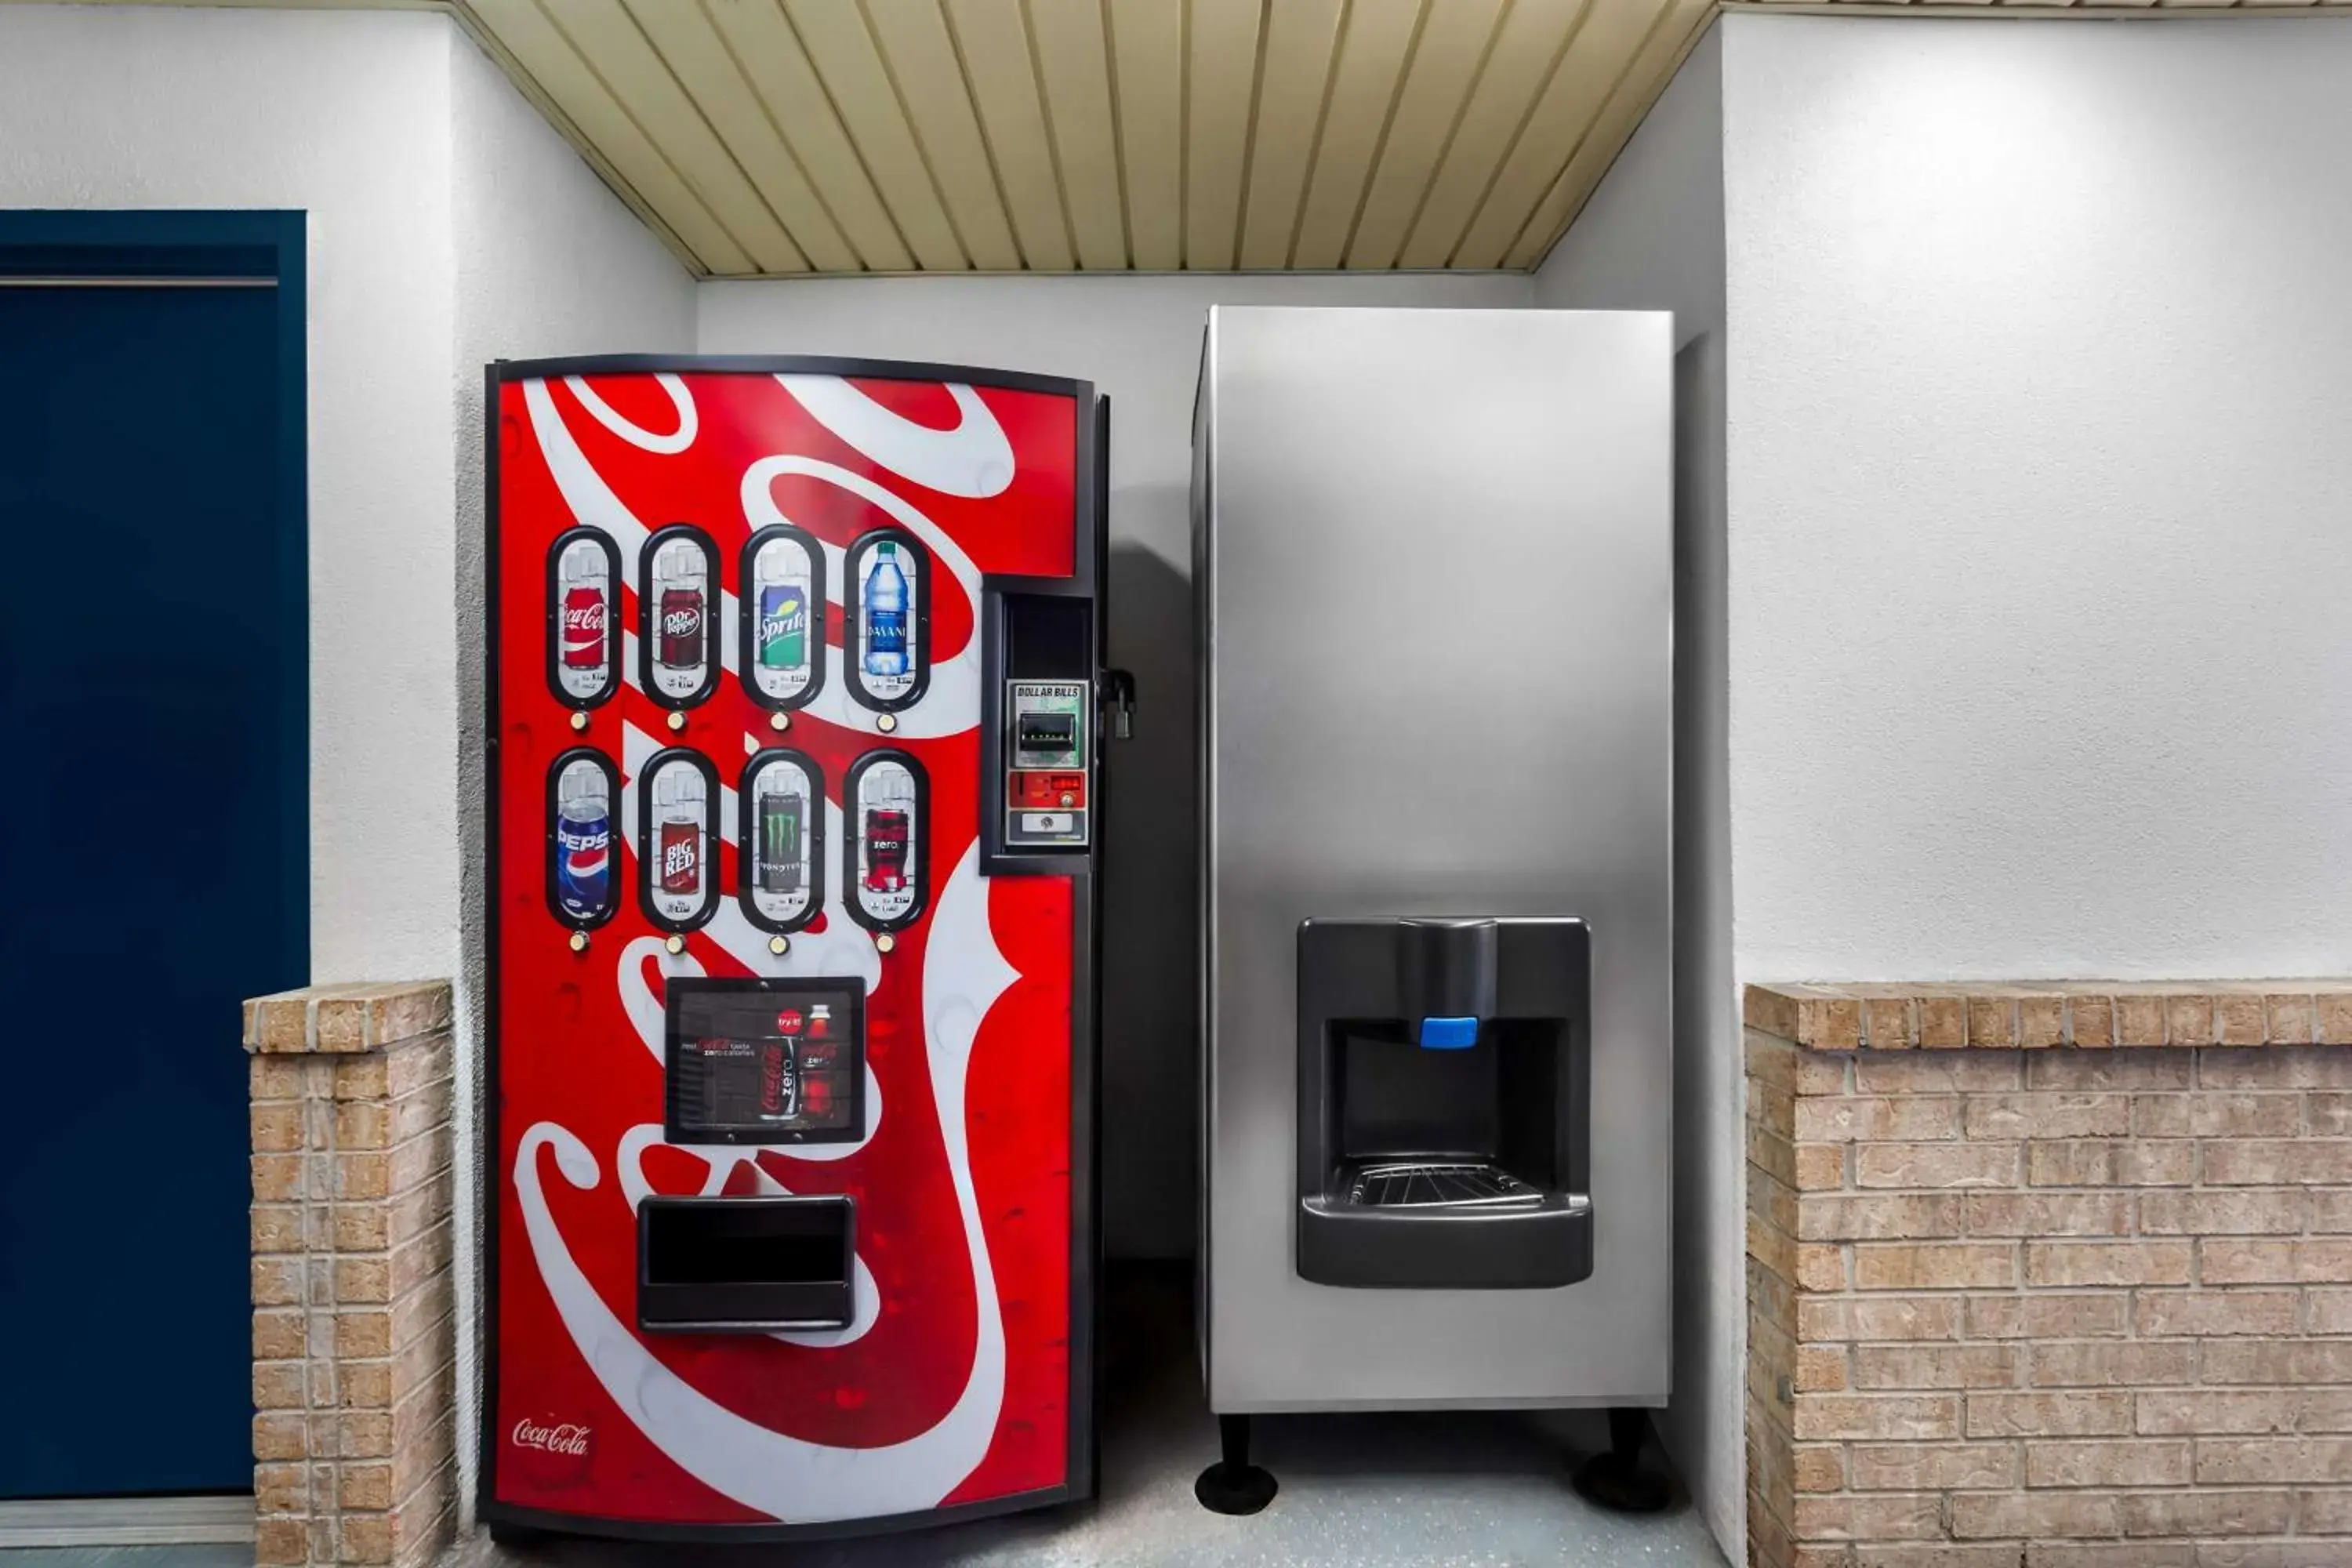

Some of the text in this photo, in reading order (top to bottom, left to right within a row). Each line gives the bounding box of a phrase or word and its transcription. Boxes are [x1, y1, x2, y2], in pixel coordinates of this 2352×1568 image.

[676, 611, 691, 624] Dr
[1018, 687, 1078, 697] DOLLAR BILLS
[558, 830, 609, 852] PEPS
[667, 838, 691, 861] BIG
[666, 852, 695, 877] RED
[782, 1059, 793, 1096] zero
[512, 1417, 592, 1457] Coca-Cola
